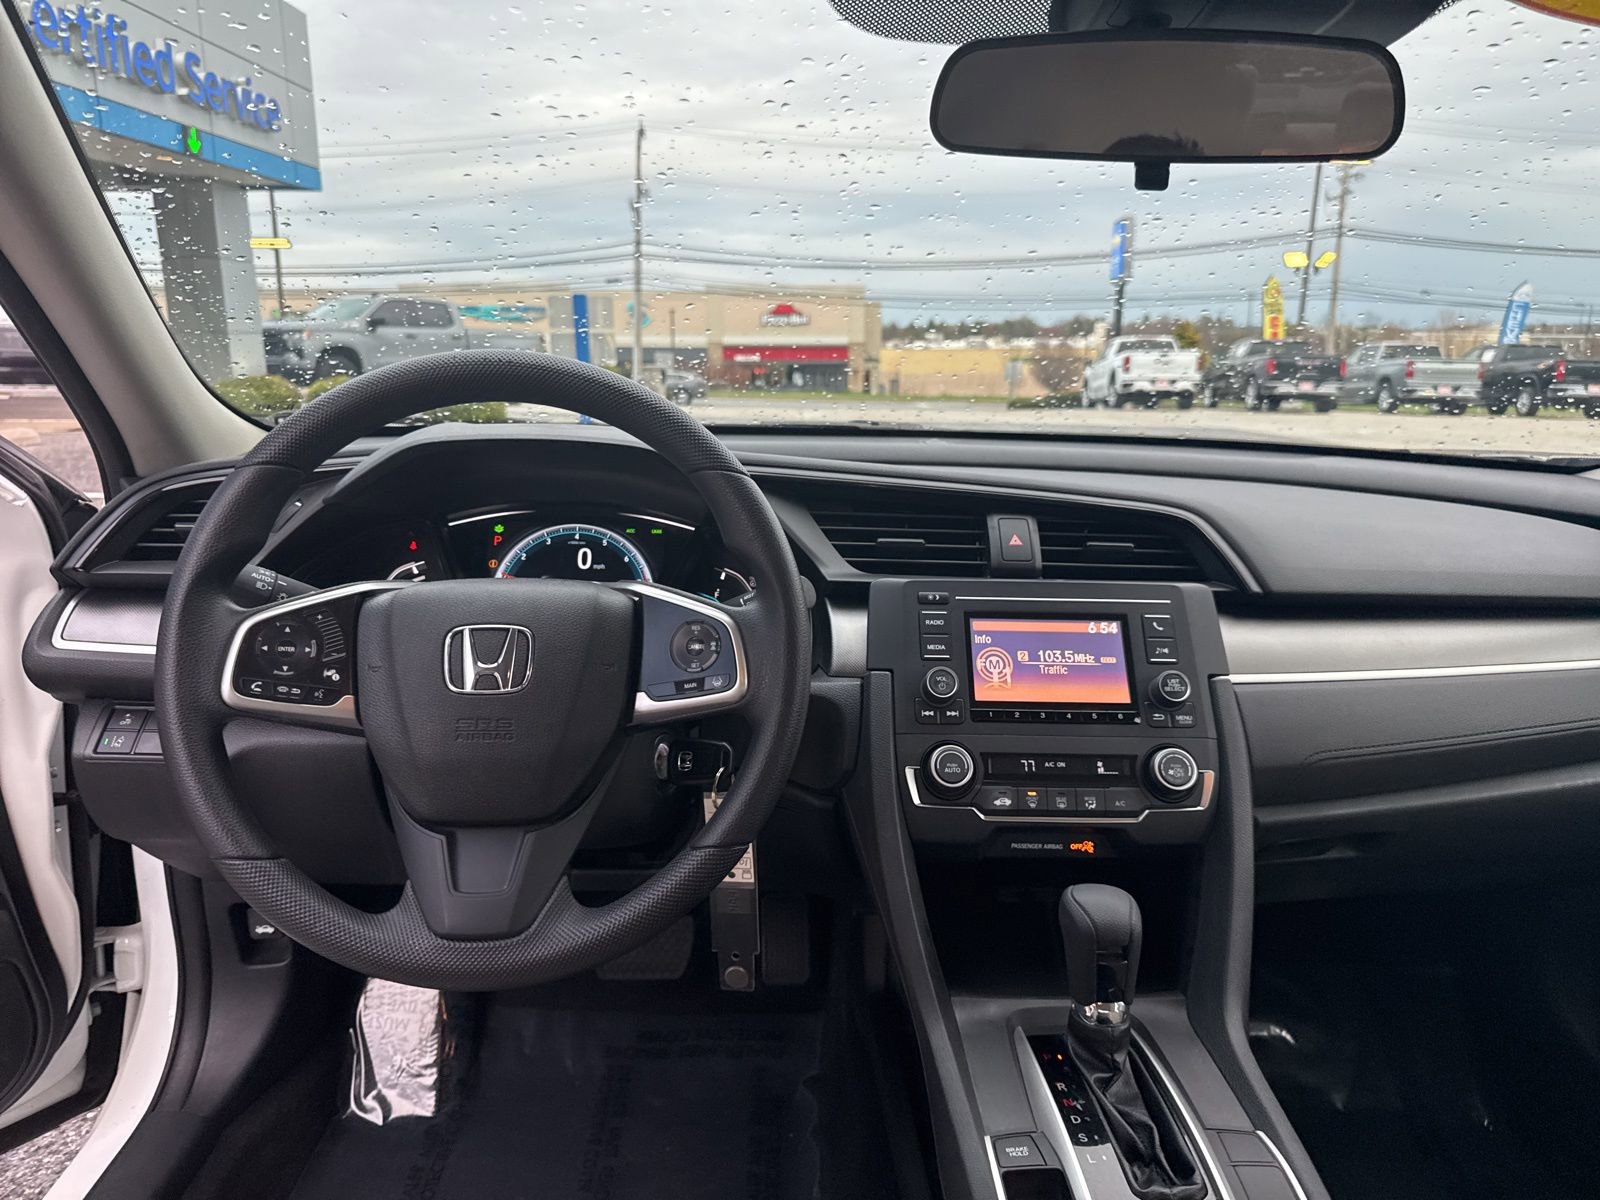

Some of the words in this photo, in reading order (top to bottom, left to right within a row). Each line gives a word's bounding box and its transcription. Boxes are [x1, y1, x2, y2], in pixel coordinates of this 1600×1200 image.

[493, 535, 503, 546] P
[545, 537, 552, 545] 3
[520, 553, 527, 561] 2
[577, 547, 593, 570] 0
[251, 572, 271, 583] AUTO
[974, 634, 992, 644] Info
[1039, 665, 1068, 675] Traffic
[1066, 712, 1072, 720] 4
[1056, 1082, 1068, 1092] R
[1070, 1115, 1081, 1124] D
[1078, 1133, 1088, 1143] S
[1086, 1153, 1097, 1164] L
